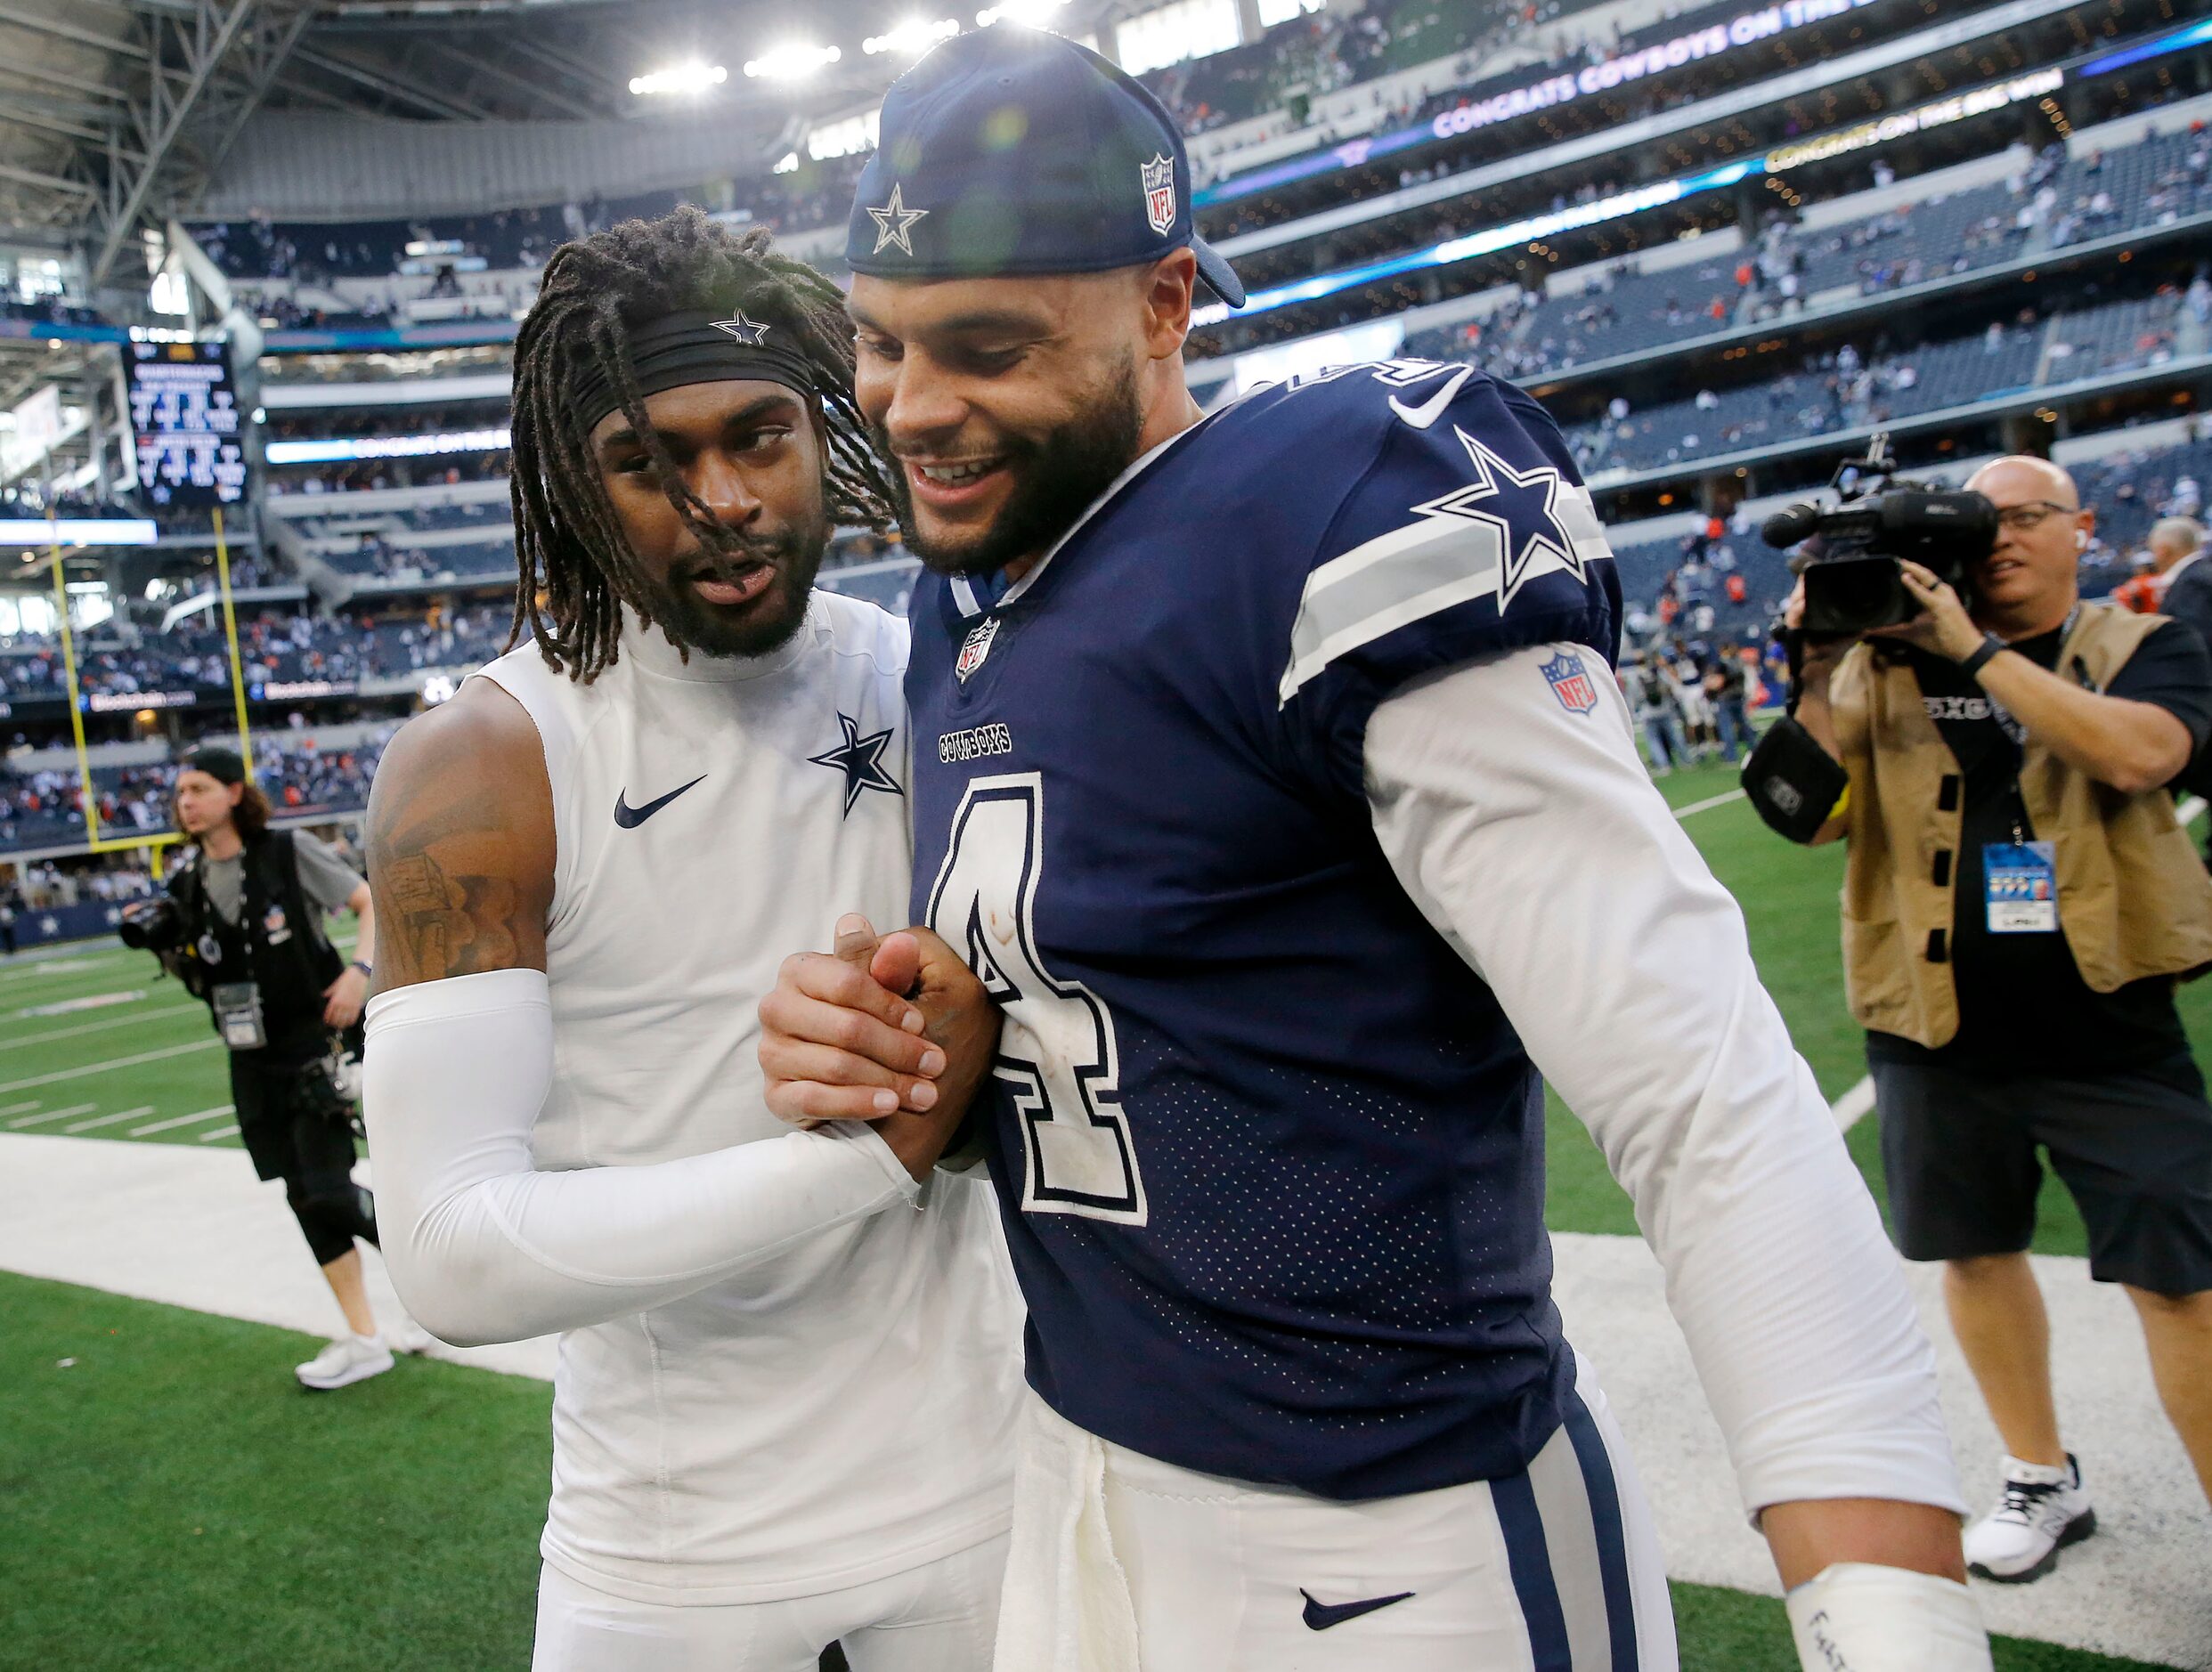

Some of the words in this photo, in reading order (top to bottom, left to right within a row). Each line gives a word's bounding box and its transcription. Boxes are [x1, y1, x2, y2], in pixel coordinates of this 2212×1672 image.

[1433, 73, 1577, 139] CONGRATS
[1578, 23, 1728, 93] COWBOYS
[1729, 7, 1782, 46] ON
[1151, 189, 1173, 223] NFL
[960, 644, 981, 669] NFL
[1555, 677, 1595, 708] NFL
[939, 723, 1012, 764] COWBOYS
[923, 771, 1148, 1227] 4
